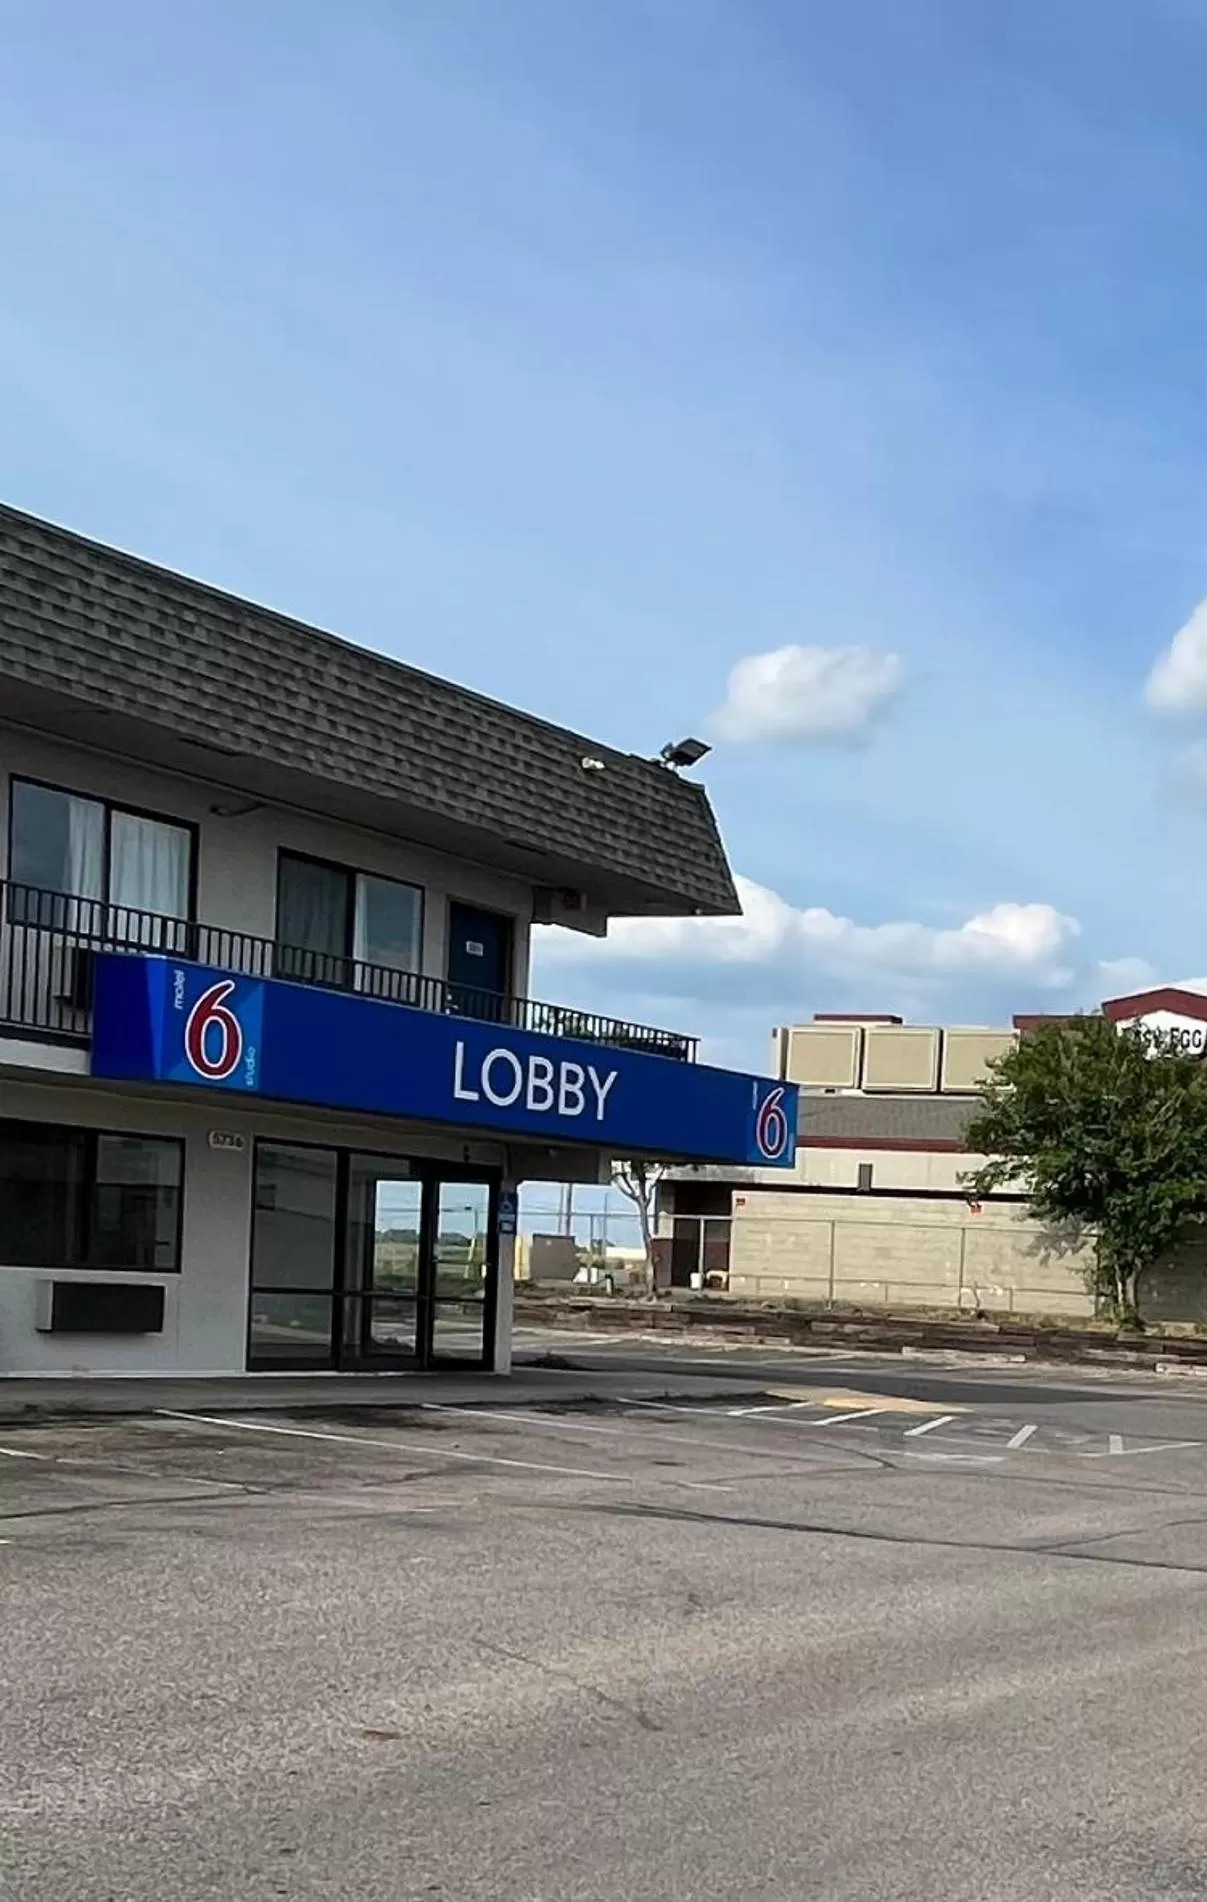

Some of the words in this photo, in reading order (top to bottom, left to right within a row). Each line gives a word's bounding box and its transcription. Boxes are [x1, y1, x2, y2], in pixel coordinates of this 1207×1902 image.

[173, 969, 185, 1010] motel
[185, 979, 242, 1080] 6
[454, 1041, 618, 1120] LOBBY
[756, 1087, 788, 1160] 6
